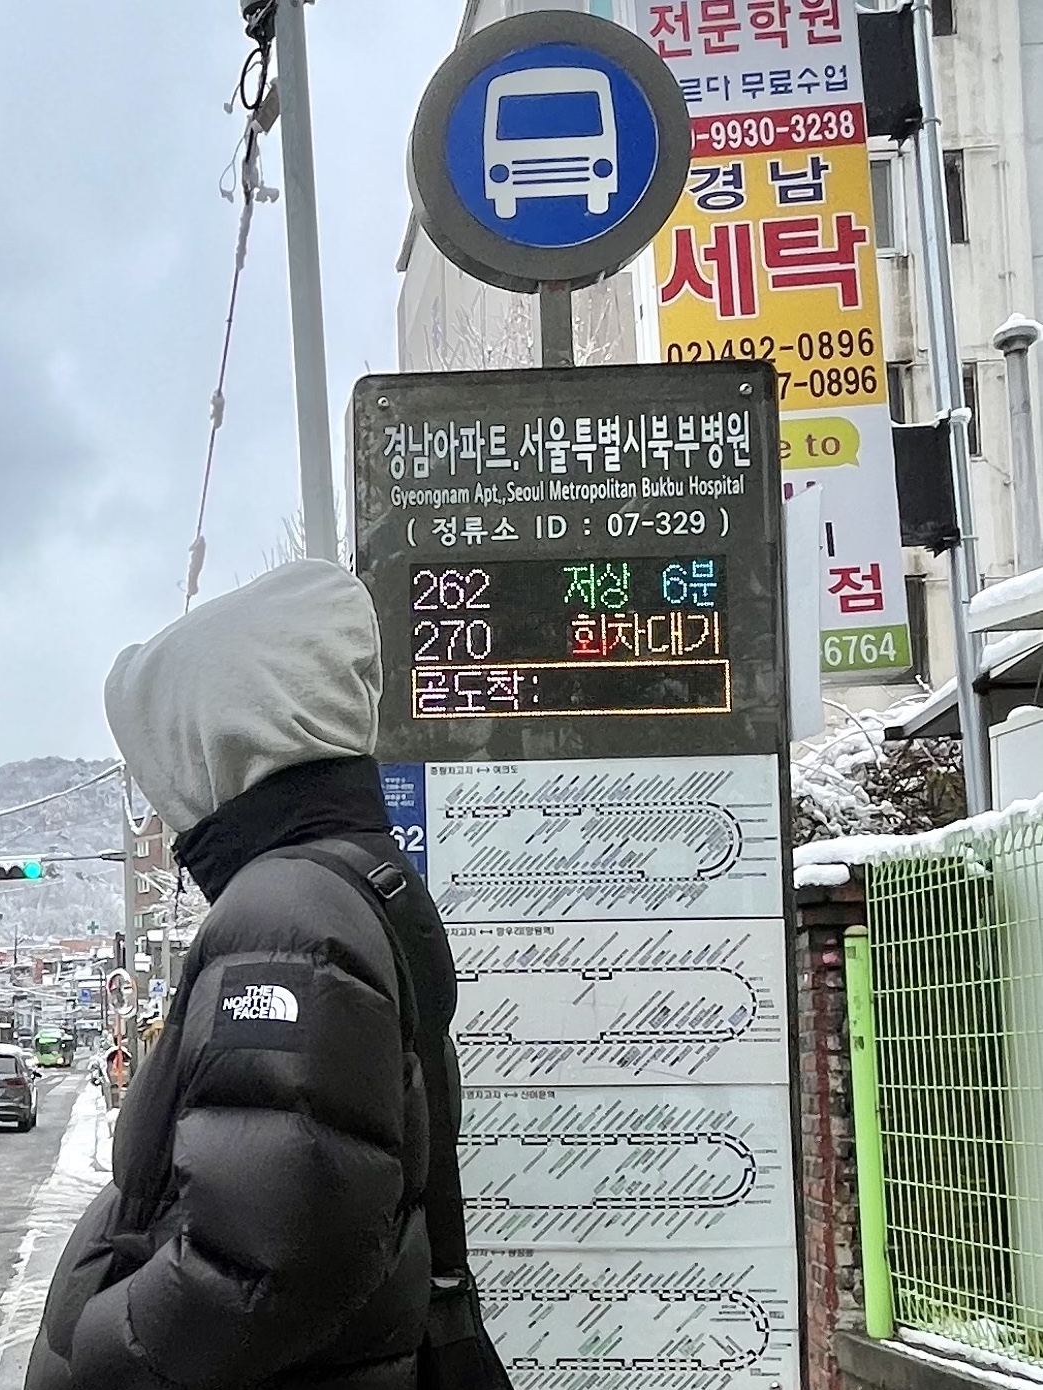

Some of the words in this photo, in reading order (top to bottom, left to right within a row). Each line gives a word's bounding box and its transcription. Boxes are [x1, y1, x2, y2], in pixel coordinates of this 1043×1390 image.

[650, 0, 843, 59] 전문학원
[742, 65, 849, 99] 무료수업
[691, 110, 856, 150] -9930-3238
[661, 215, 867, 318] 세탁
[667, 328, 875, 363] 02)492-0896
[806, 434, 841, 457] to
[391, 486, 469, 509] Gyeongnam
[549, 477, 637, 503] Metropolitan
[642, 475, 684, 498] Bukbu
[689, 474, 745, 500] Hospital
[431, 515, 519, 546] 정류소
[536, 515, 568, 539] ID
[608, 511, 706, 537] 07-329
[413, 569, 491, 610] 262
[563, 563, 631, 609] 저상
[662, 559, 718, 607] 6분
[413, 619, 492, 662] 270
[571, 611, 721, 657] 회차대기
[222, 996, 272, 1011] NORTH
[245, 985, 273, 997] THE
[232, 1007, 269, 1020] FACE
